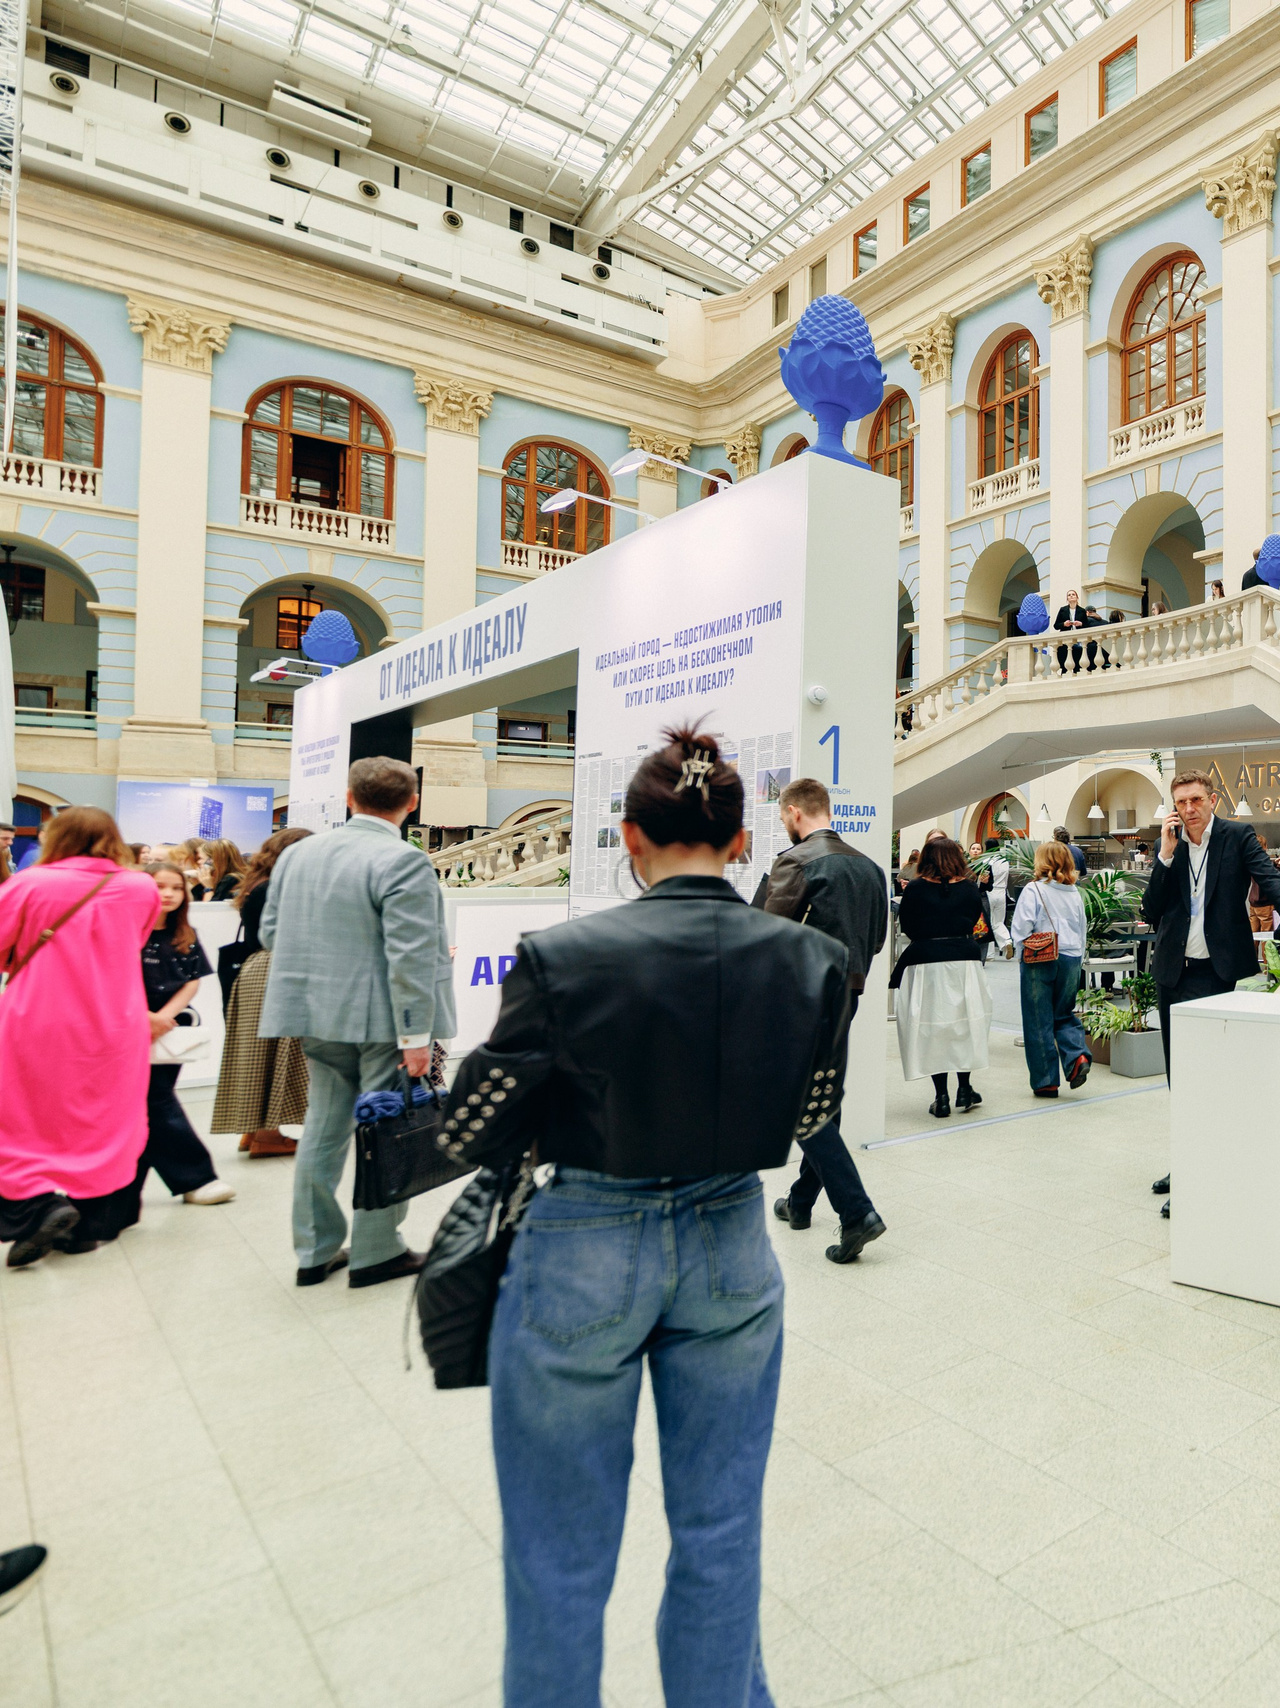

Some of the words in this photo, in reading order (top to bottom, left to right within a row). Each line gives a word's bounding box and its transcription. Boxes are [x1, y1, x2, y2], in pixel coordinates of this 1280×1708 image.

[380, 661, 393, 701] ОТ
[395, 639, 443, 700] ИДЕАЛА
[448, 632, 458, 677] К
[462, 602, 528, 677] ИДЕАЛУ
[595, 641, 637, 672] ИДЕАЛЬНЫЙ
[638, 637, 661, 658] ГОРОД
[673, 612, 743, 650] НЕДОСТИЖИМАЯ
[745, 600, 782, 628] УТОПИЯ
[612, 668, 628, 688] ИЛИ
[629, 663, 655, 685] СКОРЕЕ
[656, 658, 676, 680] ЦЕЛЬ
[678, 653, 689, 673] НА
[691, 636, 753, 669] БЕСКОНЕЧНОМ
[624, 689, 643, 709] ПУТИ
[644, 687, 654, 704] ОТ
[655, 679, 685, 704] ИДЕАЛА
[687, 677, 694, 696] К
[695, 667, 735, 695] ИДЕАЛУ?
[818, 725, 840, 785] 1
[826, 786, 851, 795] ИЛЬОН
[833, 804, 876, 818] ИДЕАЛА
